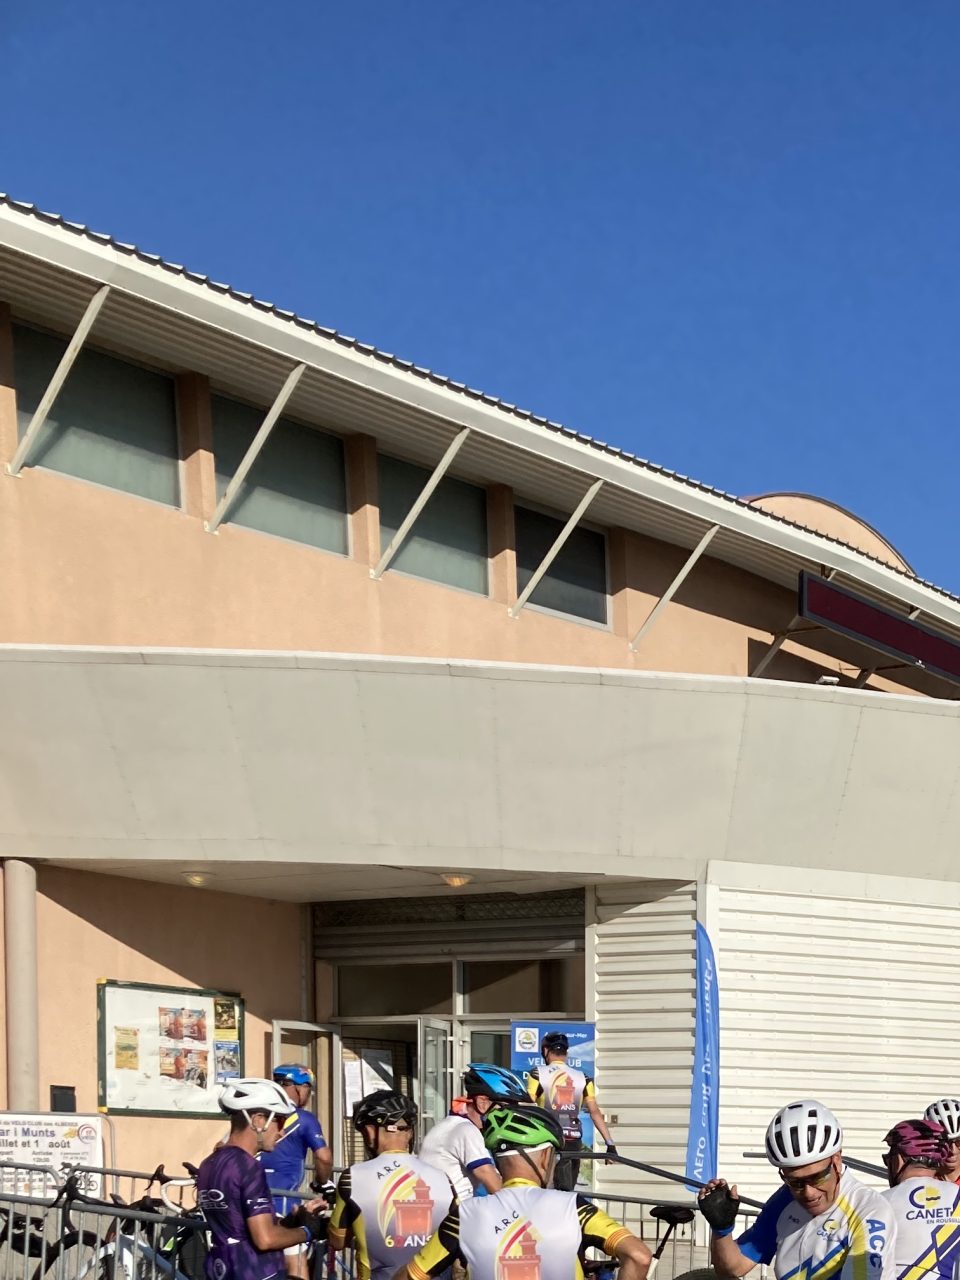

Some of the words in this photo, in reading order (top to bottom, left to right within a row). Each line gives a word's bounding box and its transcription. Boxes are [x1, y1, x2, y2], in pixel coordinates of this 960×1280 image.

[528, 1057, 546, 1066] VEL
[22, 1127, 56, 1138] Munts
[21, 1140, 31, 1148] et
[34, 1140, 39, 1148] 1
[48, 1139, 71, 1149] août
[906, 1207, 952, 1221] CANET
[866, 1219, 886, 1269] ACC
